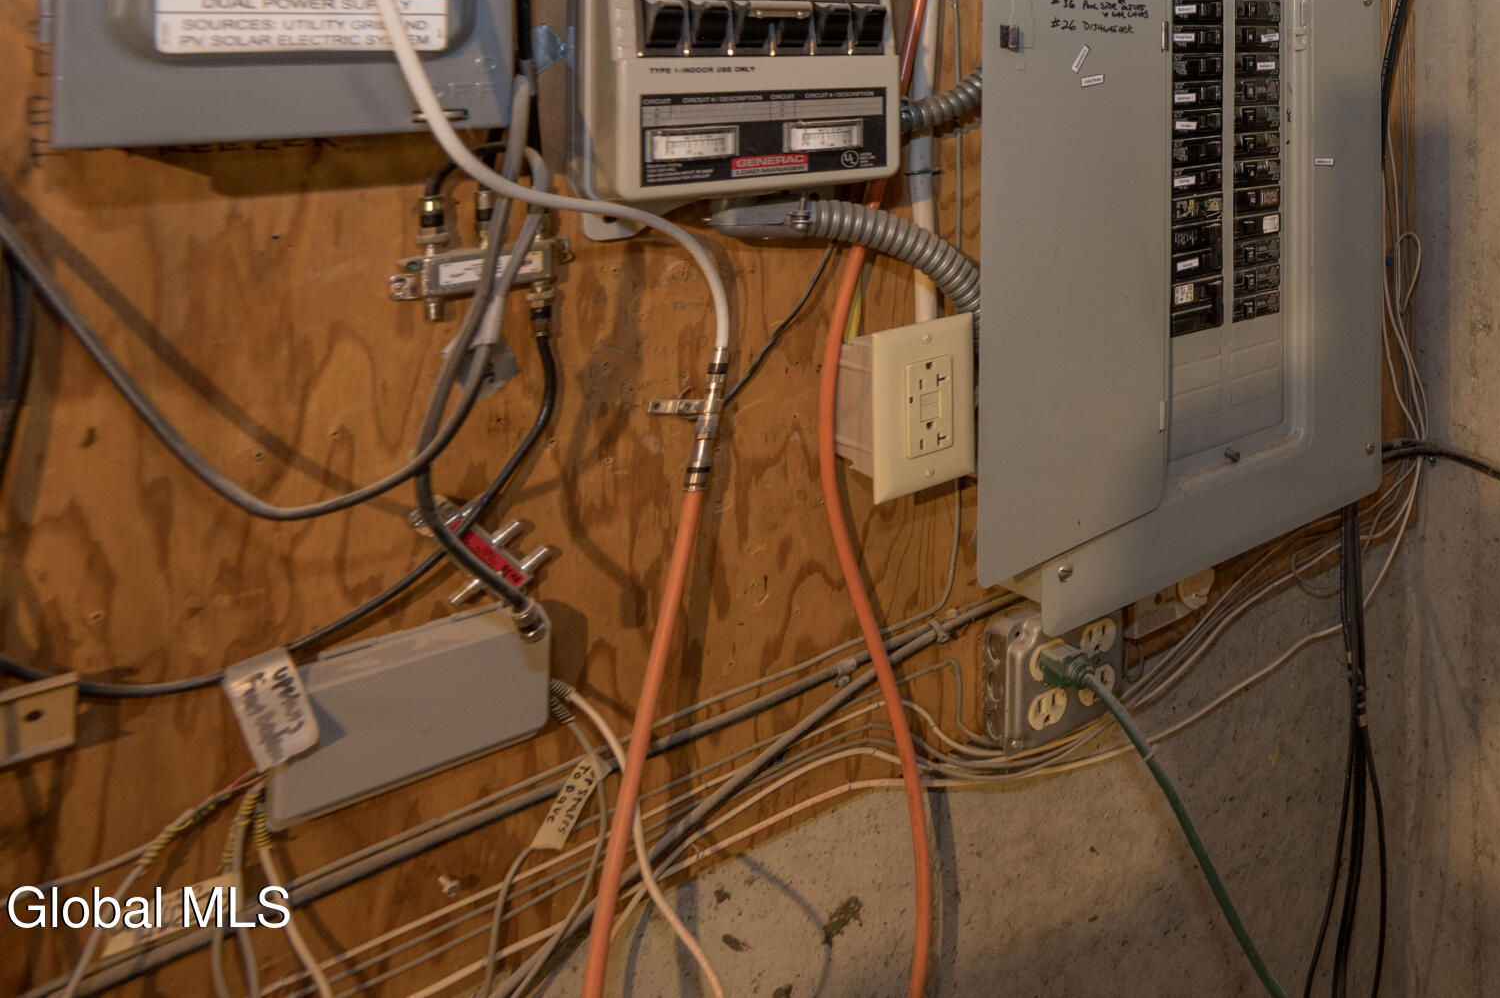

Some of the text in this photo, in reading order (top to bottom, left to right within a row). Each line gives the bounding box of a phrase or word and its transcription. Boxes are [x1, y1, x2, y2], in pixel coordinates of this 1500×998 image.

[181, 18, 279, 32] SOURCES:
[284, 19, 346, 32] UTILITY
[179, 34, 208, 47] PV
[210, 34, 271, 48] SOLAR
[278, 34, 362, 48] ELECTRIC
[736, 154, 805, 168] GENERAC
